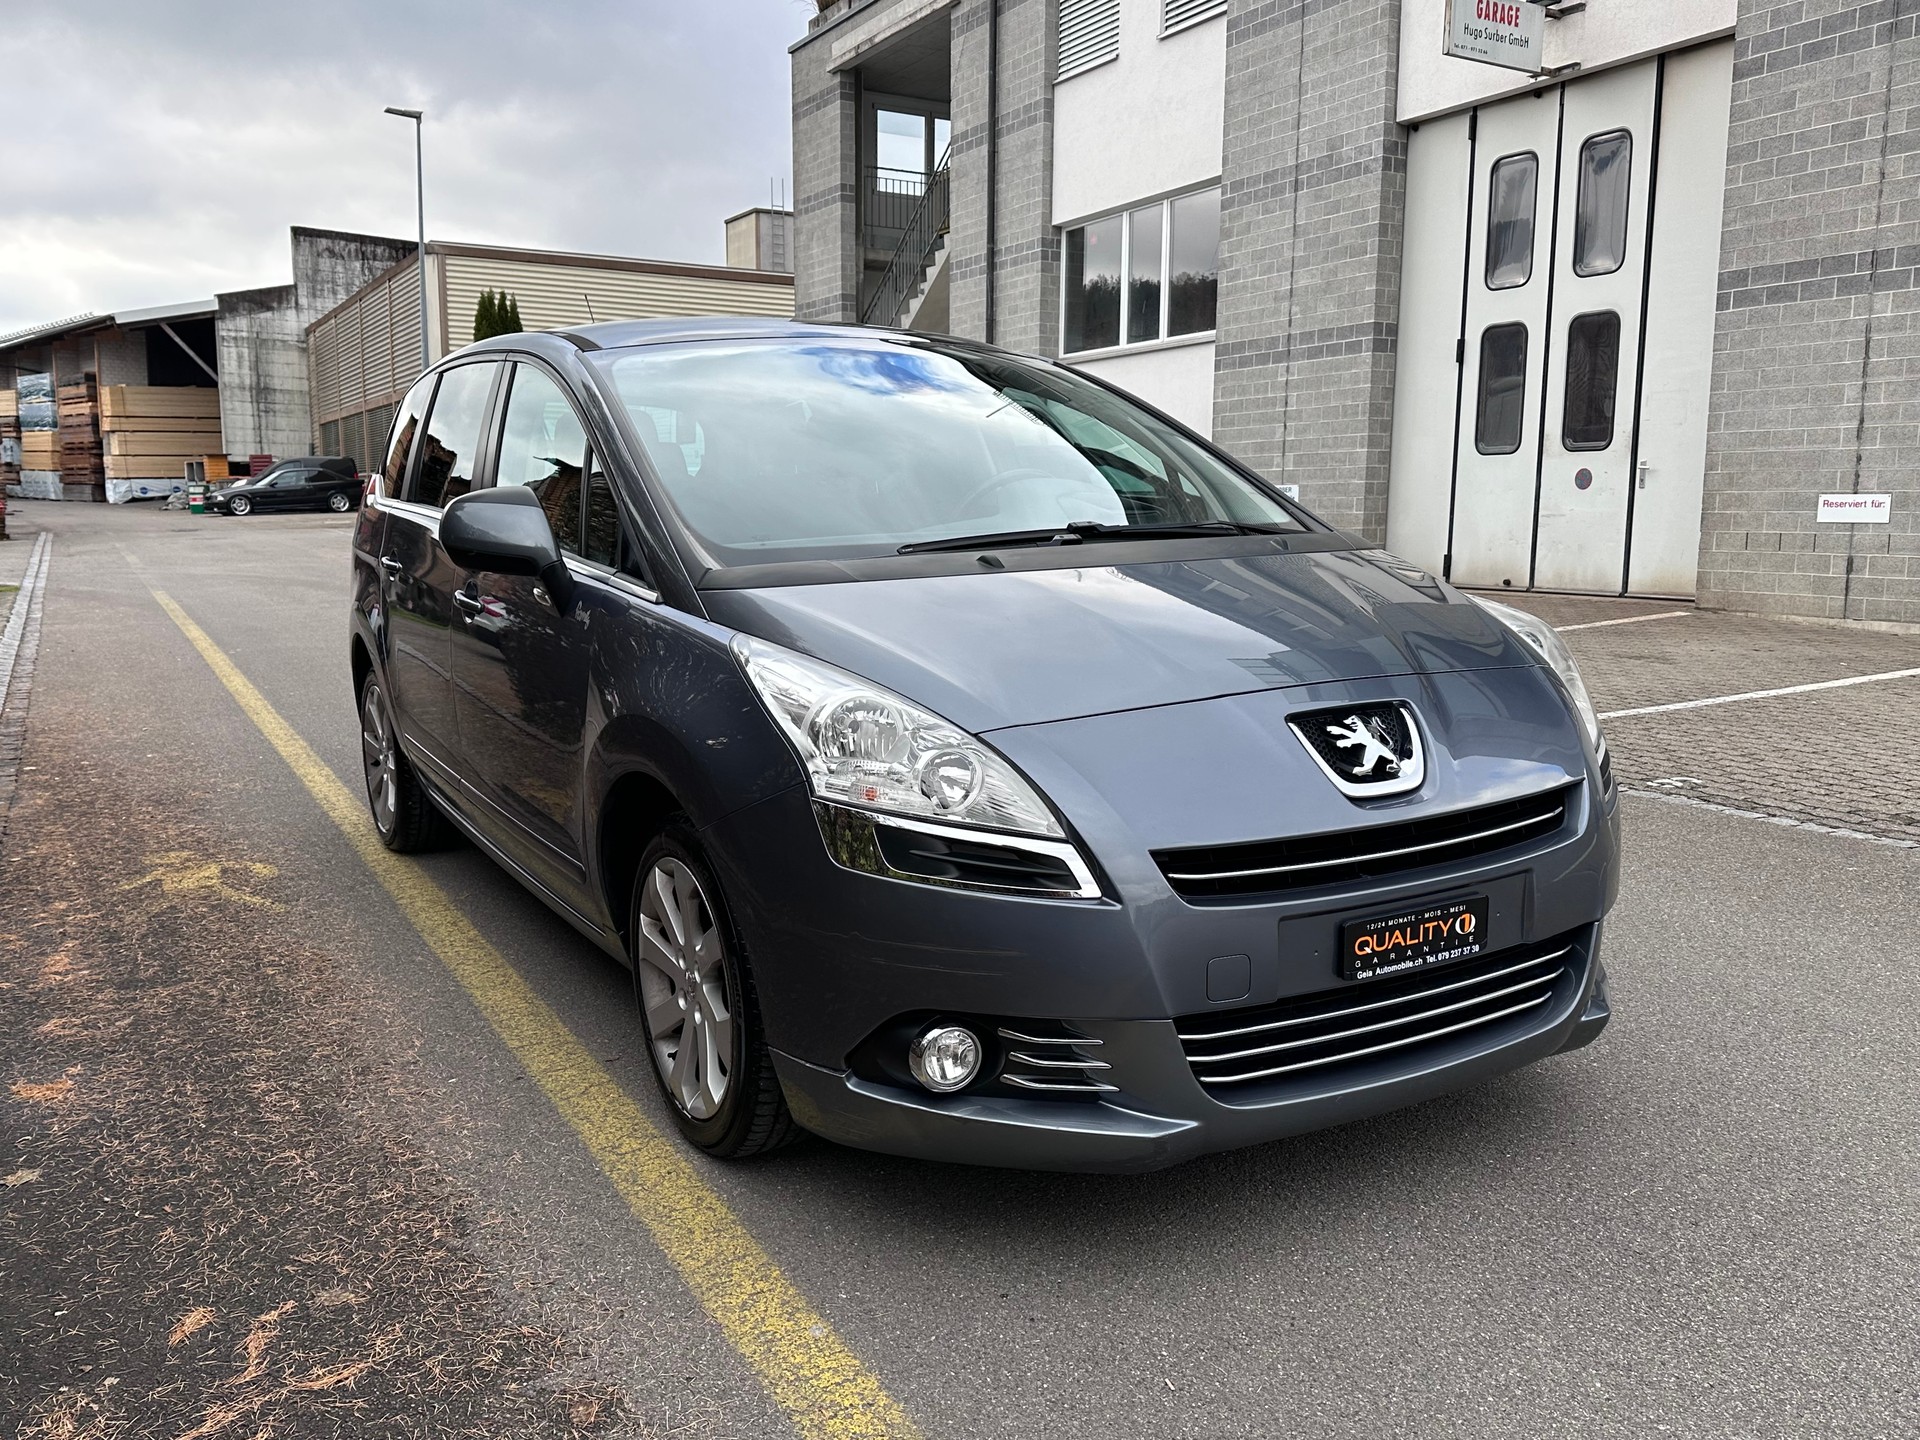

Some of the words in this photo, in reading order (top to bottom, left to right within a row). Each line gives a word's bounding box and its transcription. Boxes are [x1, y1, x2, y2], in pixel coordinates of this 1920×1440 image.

[1476, 0, 1521, 28] GARAGE
[1463, 22, 1483, 40] Hugo
[1484, 27, 1508, 44] Surber
[1508, 33, 1530, 49] GmbH
[1822, 499, 1867, 508] Reserviert
[1871, 499, 1886, 508] für:
[1366, 922, 1386, 931] 12/24
[1388, 914, 1416, 926] MONATE
[1424, 909, 1442, 919] MOIS
[1450, 904, 1466, 913] MESI
[1354, 918, 1454, 956] QUALITY
[1354, 935, 1475, 968] GARANTIE
[1375, 957, 1424, 976] Automobile.ch
[1426, 954, 1437, 963] Tel.
[1437, 951, 1450, 961] 079
[1450, 948, 1462, 958] 237
[1463, 946, 1471, 955] 37
